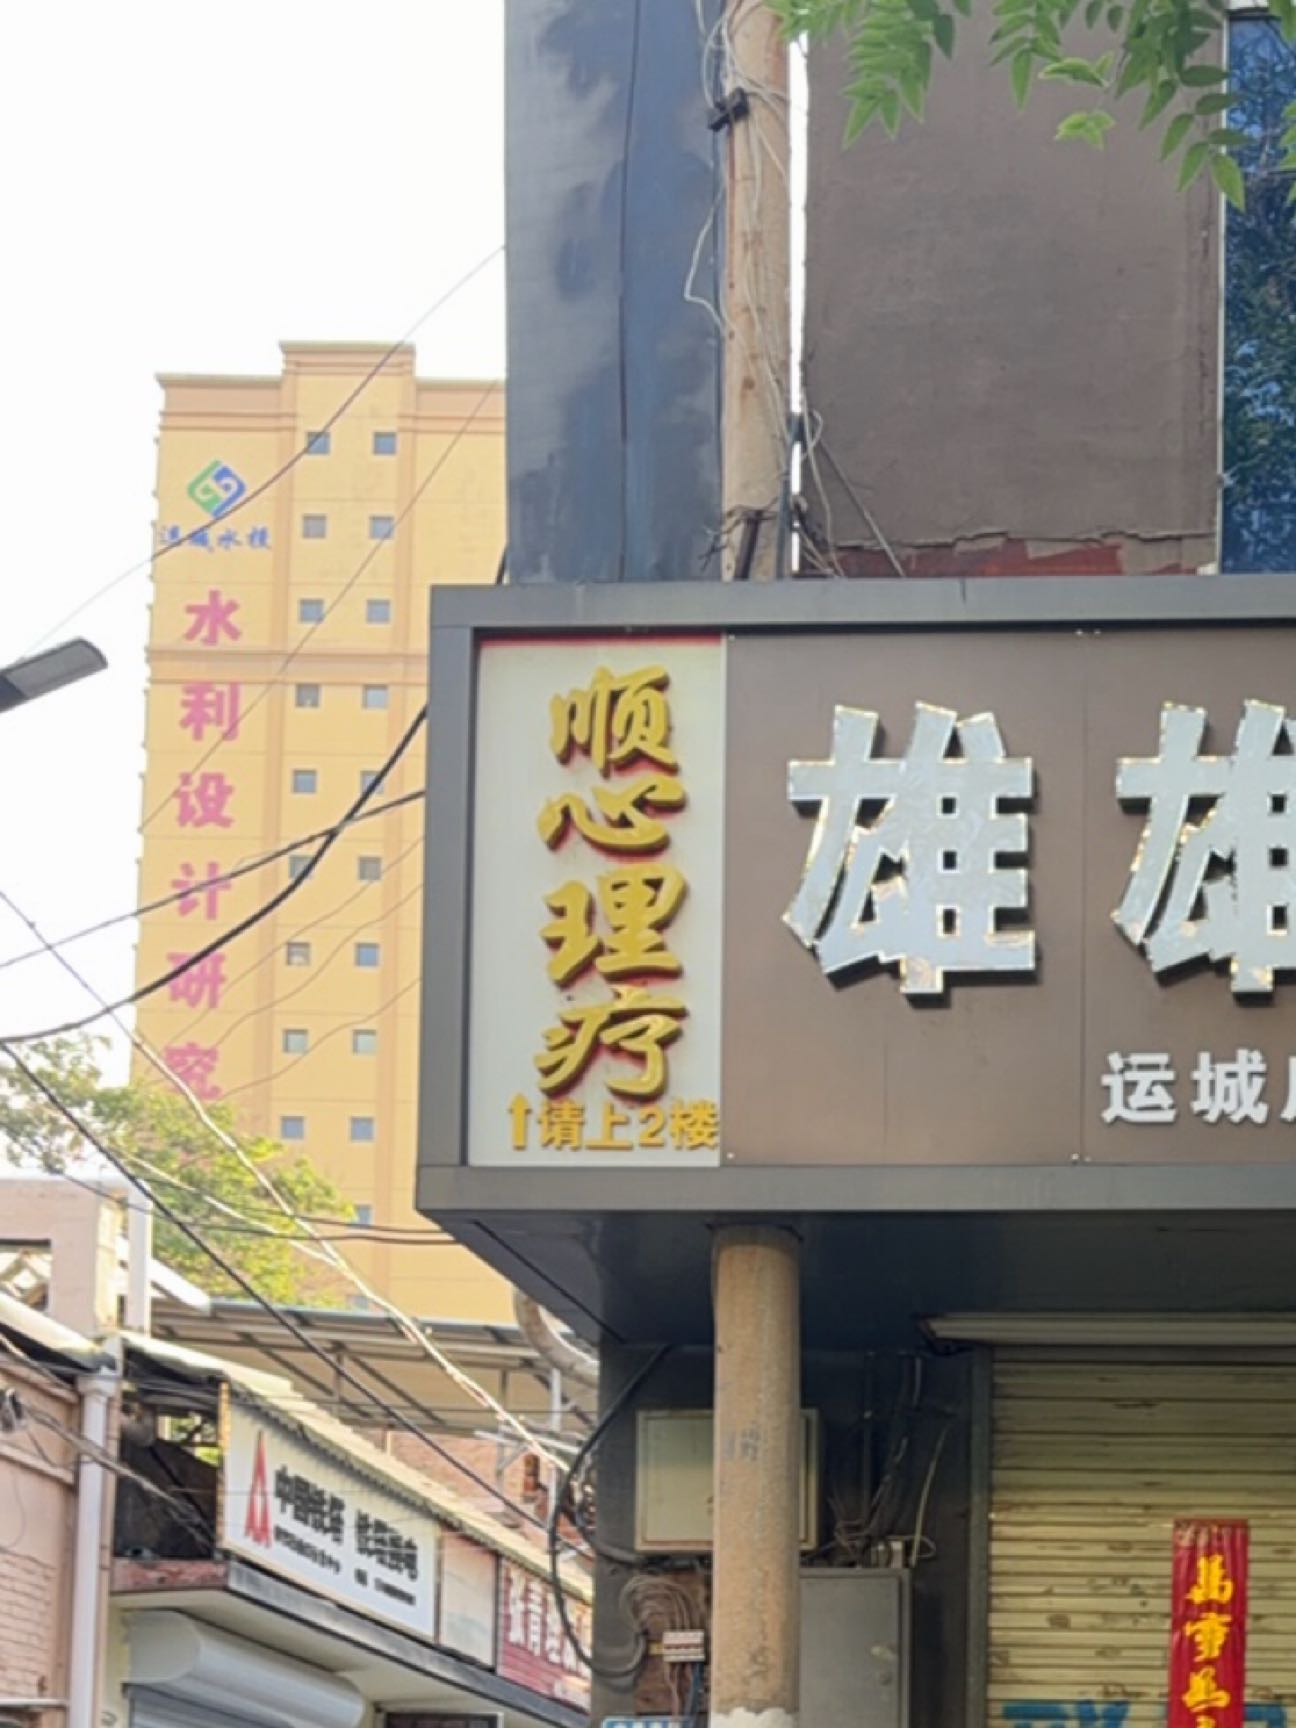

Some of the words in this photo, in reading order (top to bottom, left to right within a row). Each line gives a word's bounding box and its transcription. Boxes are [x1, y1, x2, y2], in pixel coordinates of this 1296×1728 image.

[535, 665, 688, 1098] 顺心理疗
[538, 1097, 720, 1152] 请上2楼
